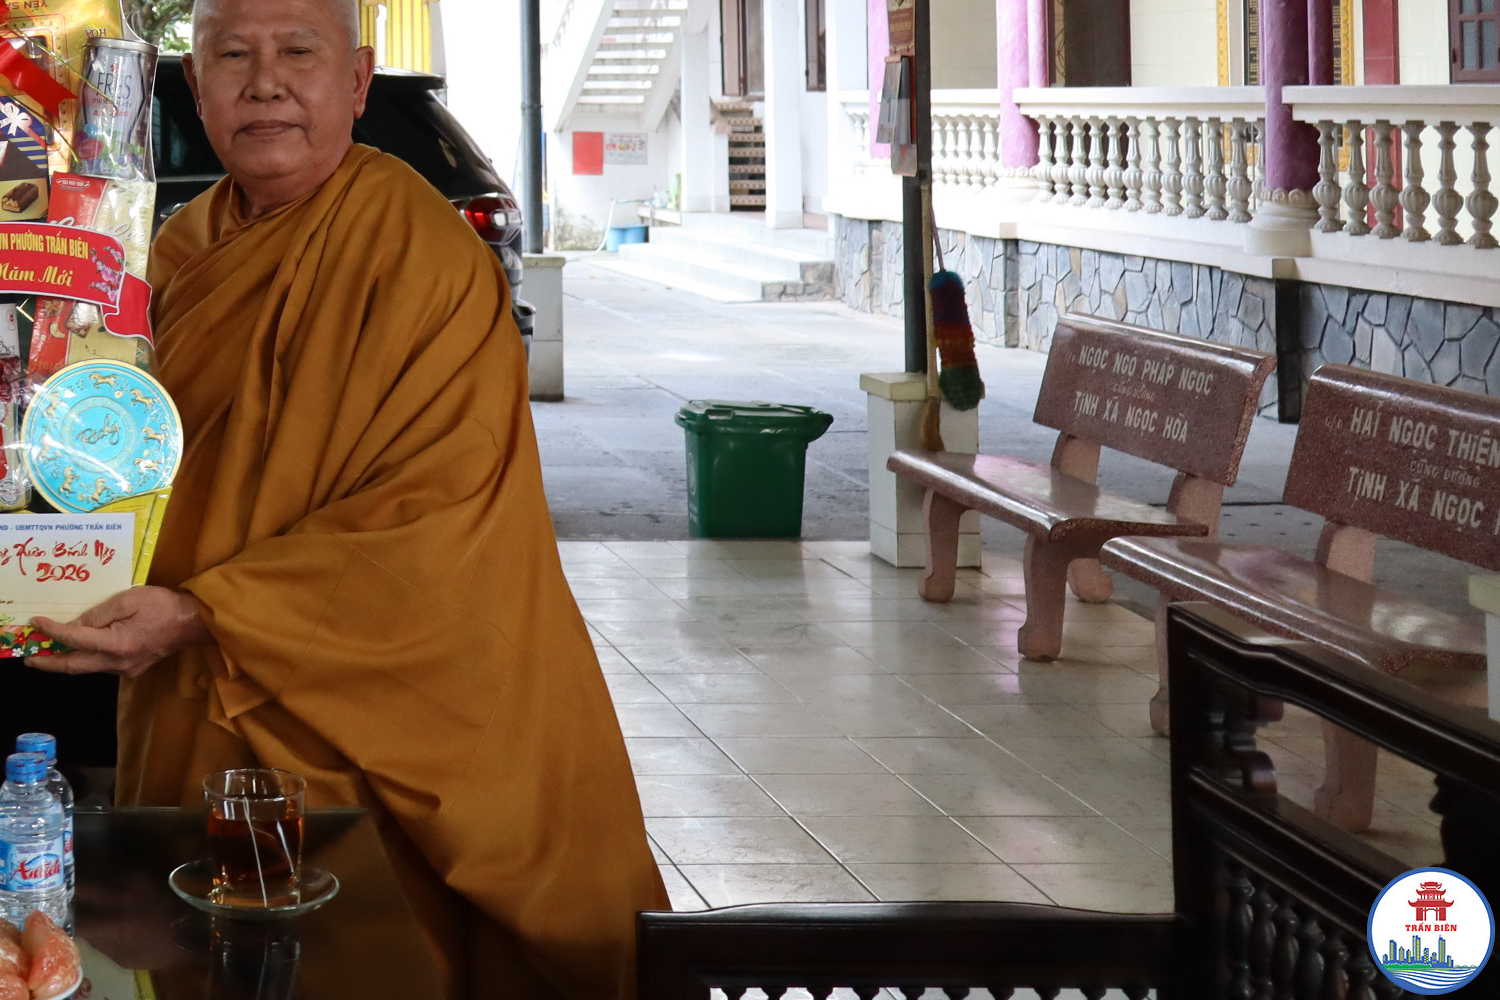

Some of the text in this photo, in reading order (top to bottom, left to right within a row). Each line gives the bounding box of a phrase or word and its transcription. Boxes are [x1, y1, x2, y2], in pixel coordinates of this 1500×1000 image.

[10, 229, 45, 252] PHƯỜNG
[45, 230, 68, 255] TRẤN
[69, 237, 89, 259] BIÊN
[38, 265, 74, 287] Mới
[1078, 345, 1109, 373] NGỌC
[1142, 357, 1175, 386] PHÁP
[1178, 368, 1214, 399] NGỌC
[1124, 405, 1158, 436] NGỌC
[1163, 412, 1189, 443] HÒA
[1389, 416, 1438, 454] NGỌC
[15, 524, 53, 532] UBMTTQVN
[55, 522, 83, 530] PHƯỜNG
[85, 522, 104, 530] TRẤN
[105, 522, 123, 530] BIÊN
[1430, 490, 1484, 532] NGỌC
[36, 562, 90, 582] 2026
